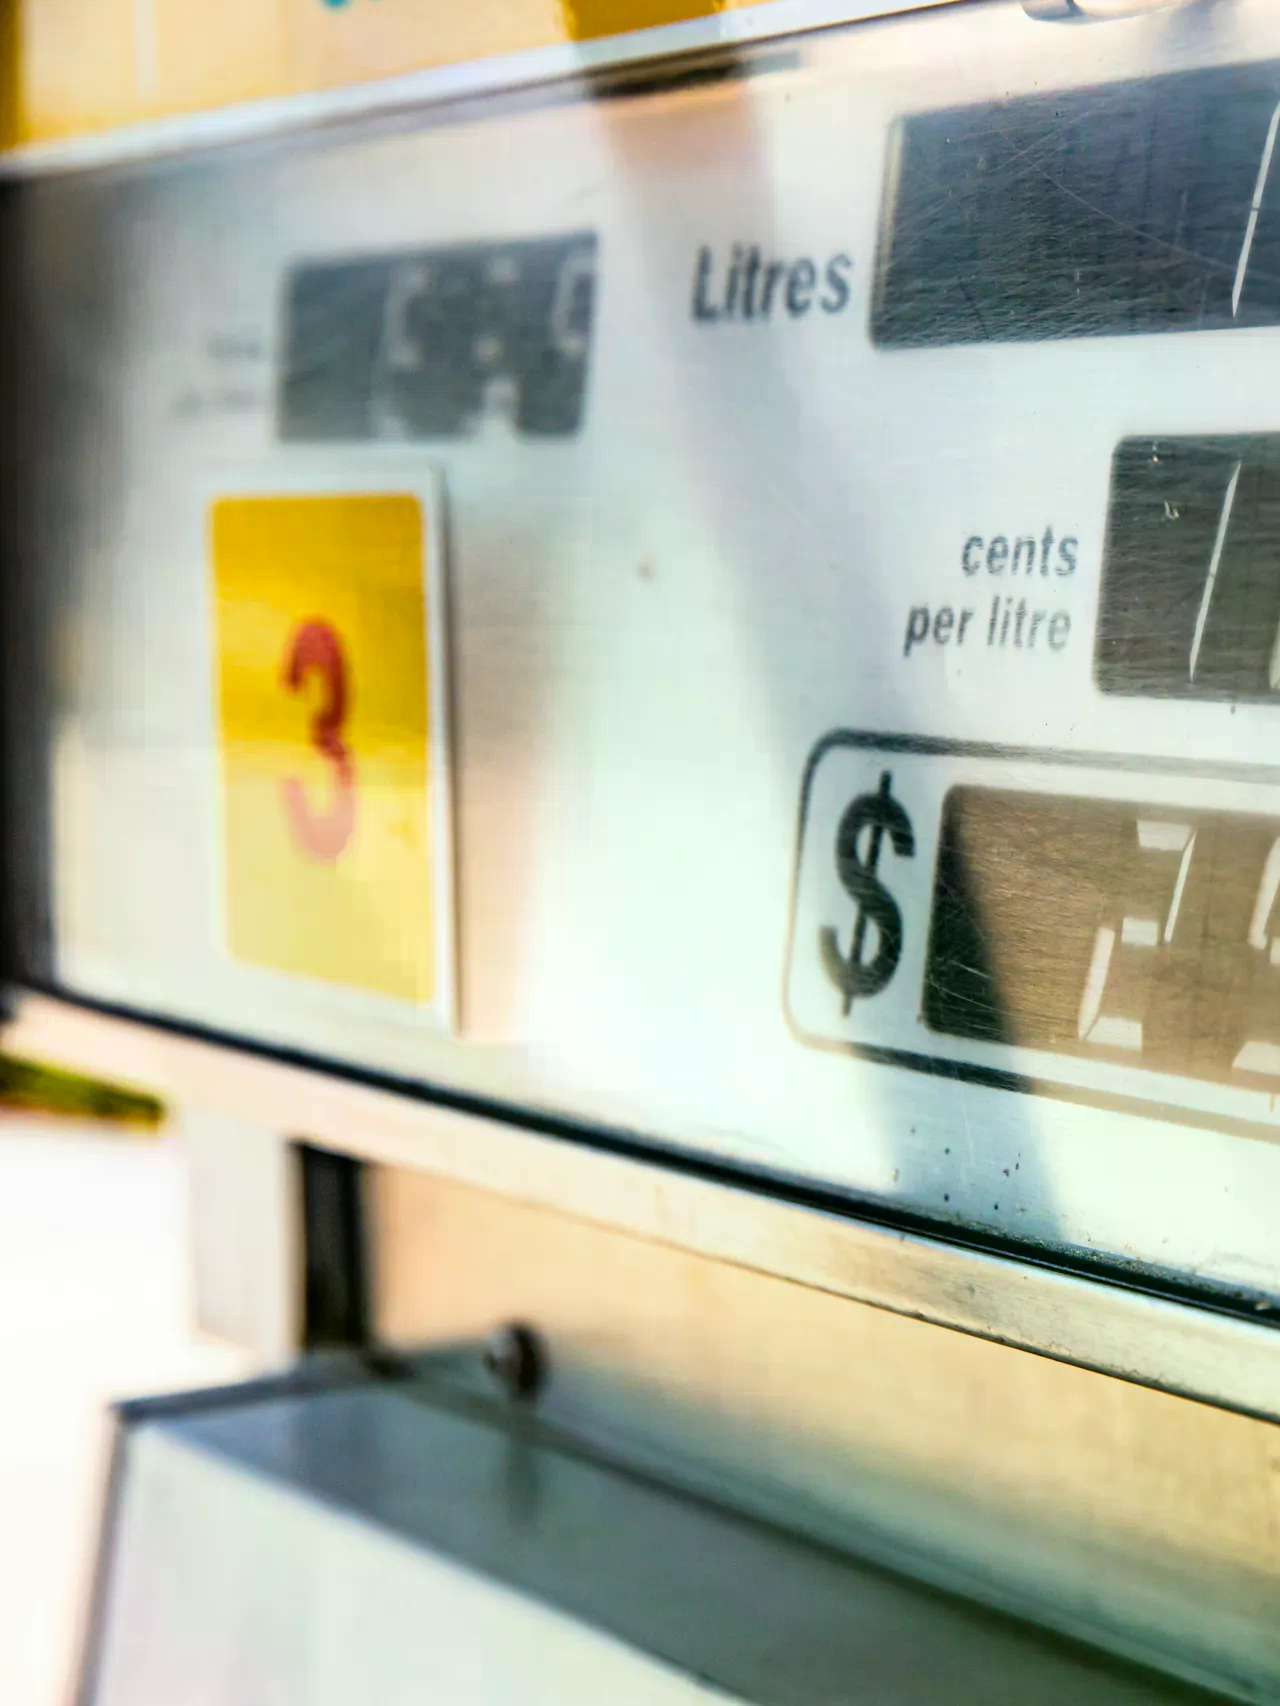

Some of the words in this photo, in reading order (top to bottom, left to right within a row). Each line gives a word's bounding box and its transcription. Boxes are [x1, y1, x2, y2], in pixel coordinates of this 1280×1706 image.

[692, 243, 852, 319] Litres
[961, 524, 1079, 577] cents
[903, 604, 974, 657] per
[986, 595, 1072, 651] litre
[282, 617, 358, 865] 3
[818, 768, 916, 1018] $
